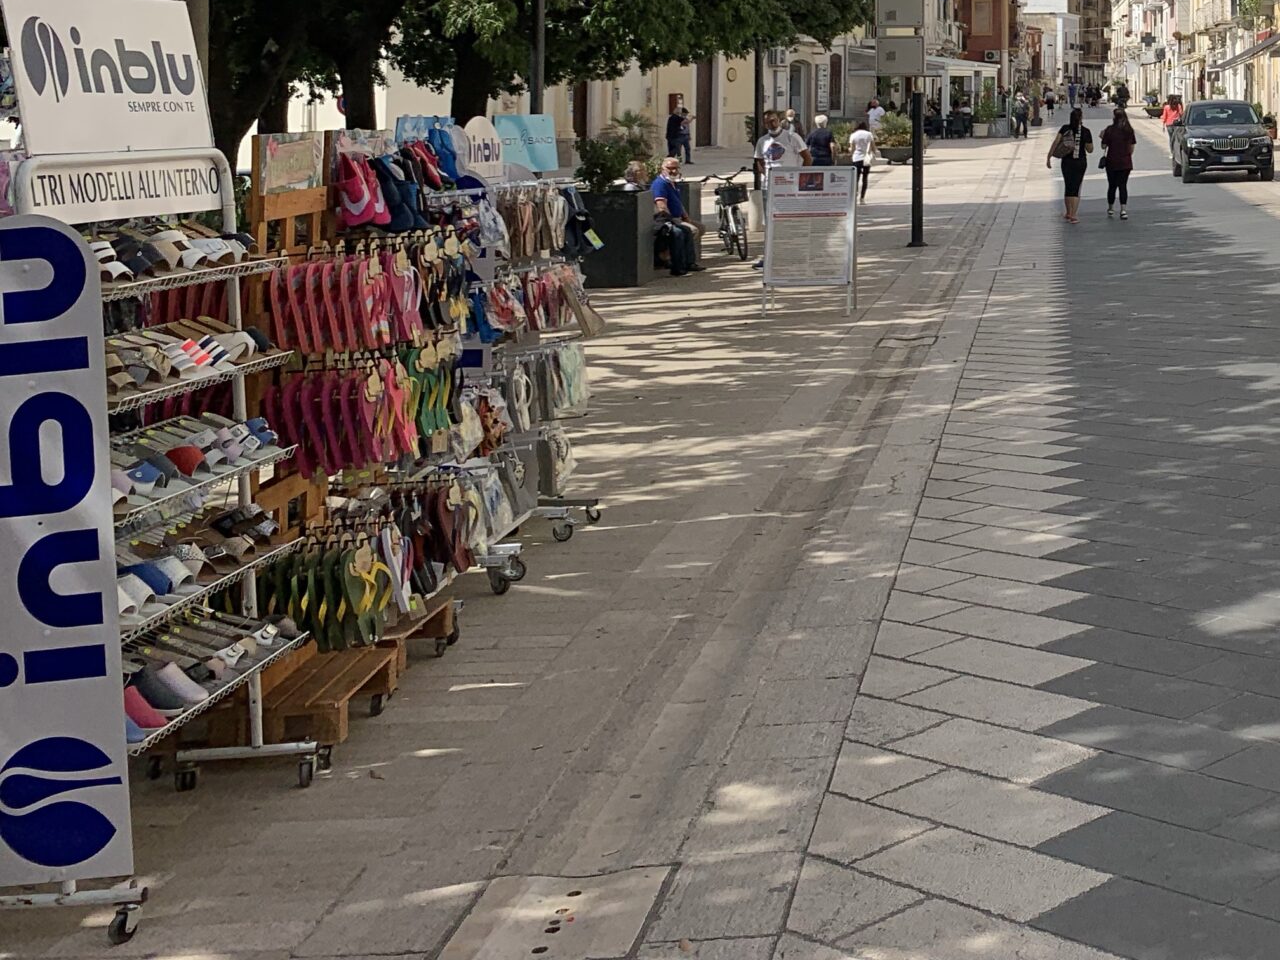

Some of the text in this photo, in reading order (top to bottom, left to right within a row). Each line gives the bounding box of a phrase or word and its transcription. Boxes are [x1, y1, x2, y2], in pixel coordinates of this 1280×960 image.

[69, 26, 195, 96] inblu
[128, 101, 196, 113] SEMPRE CON TE
[472, 134, 500, 163] inblu
[68, 170, 135, 204] MODELLI
[138, 166, 220, 199] ALL'INTERNO
